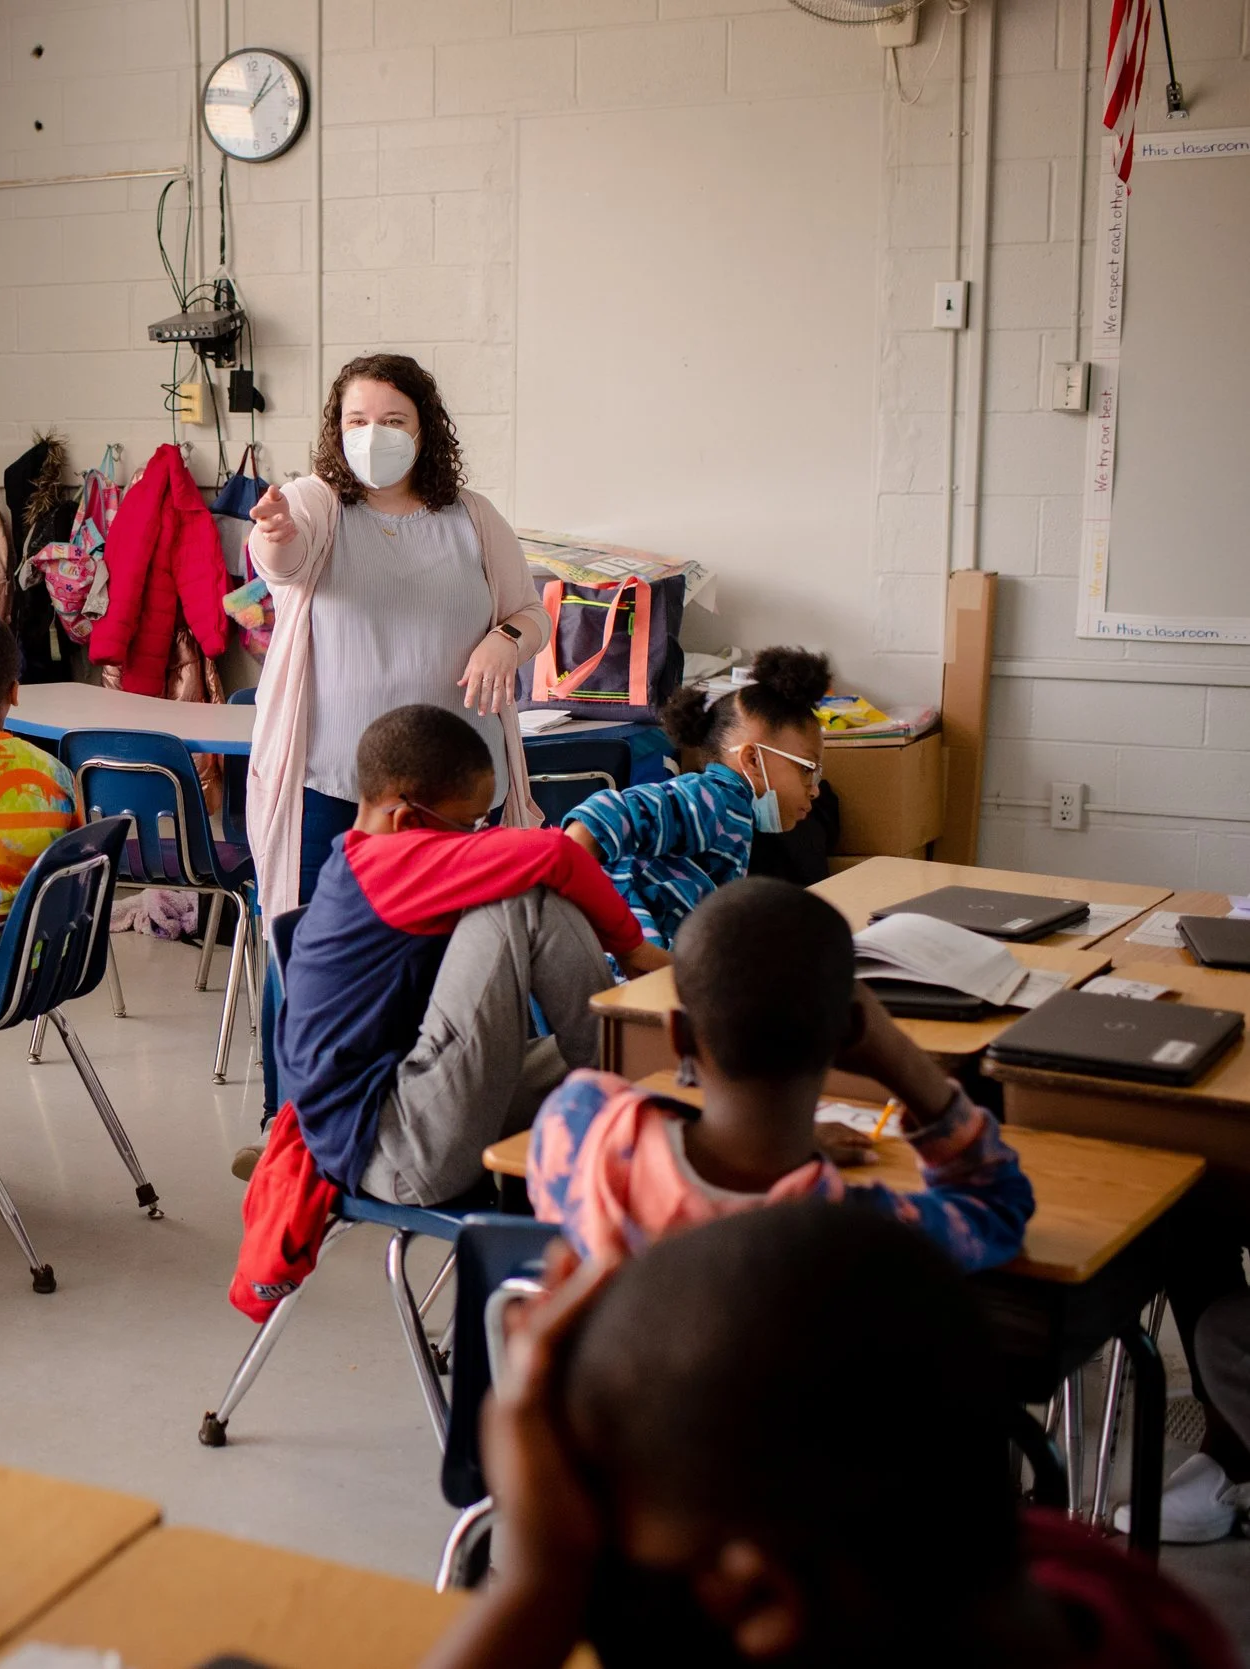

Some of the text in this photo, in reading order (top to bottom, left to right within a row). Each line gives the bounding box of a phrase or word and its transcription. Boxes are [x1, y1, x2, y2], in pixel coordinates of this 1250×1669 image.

[246, 60, 258, 72] 12
[287, 96, 295, 107] 3
[253, 140, 260, 151] 6
[270, 132, 278, 144] 5
[1142, 141, 1250, 157] this classroom
[1103, 184, 1124, 334] We respect each other
[1101, 423, 1110, 445] our
[1096, 449, 1112, 467] try
[1094, 473, 1109, 492] We
[1097, 620, 1110, 634] In
[1116, 622, 1142, 636] this
[1146, 624, 1220, 639] classroom
